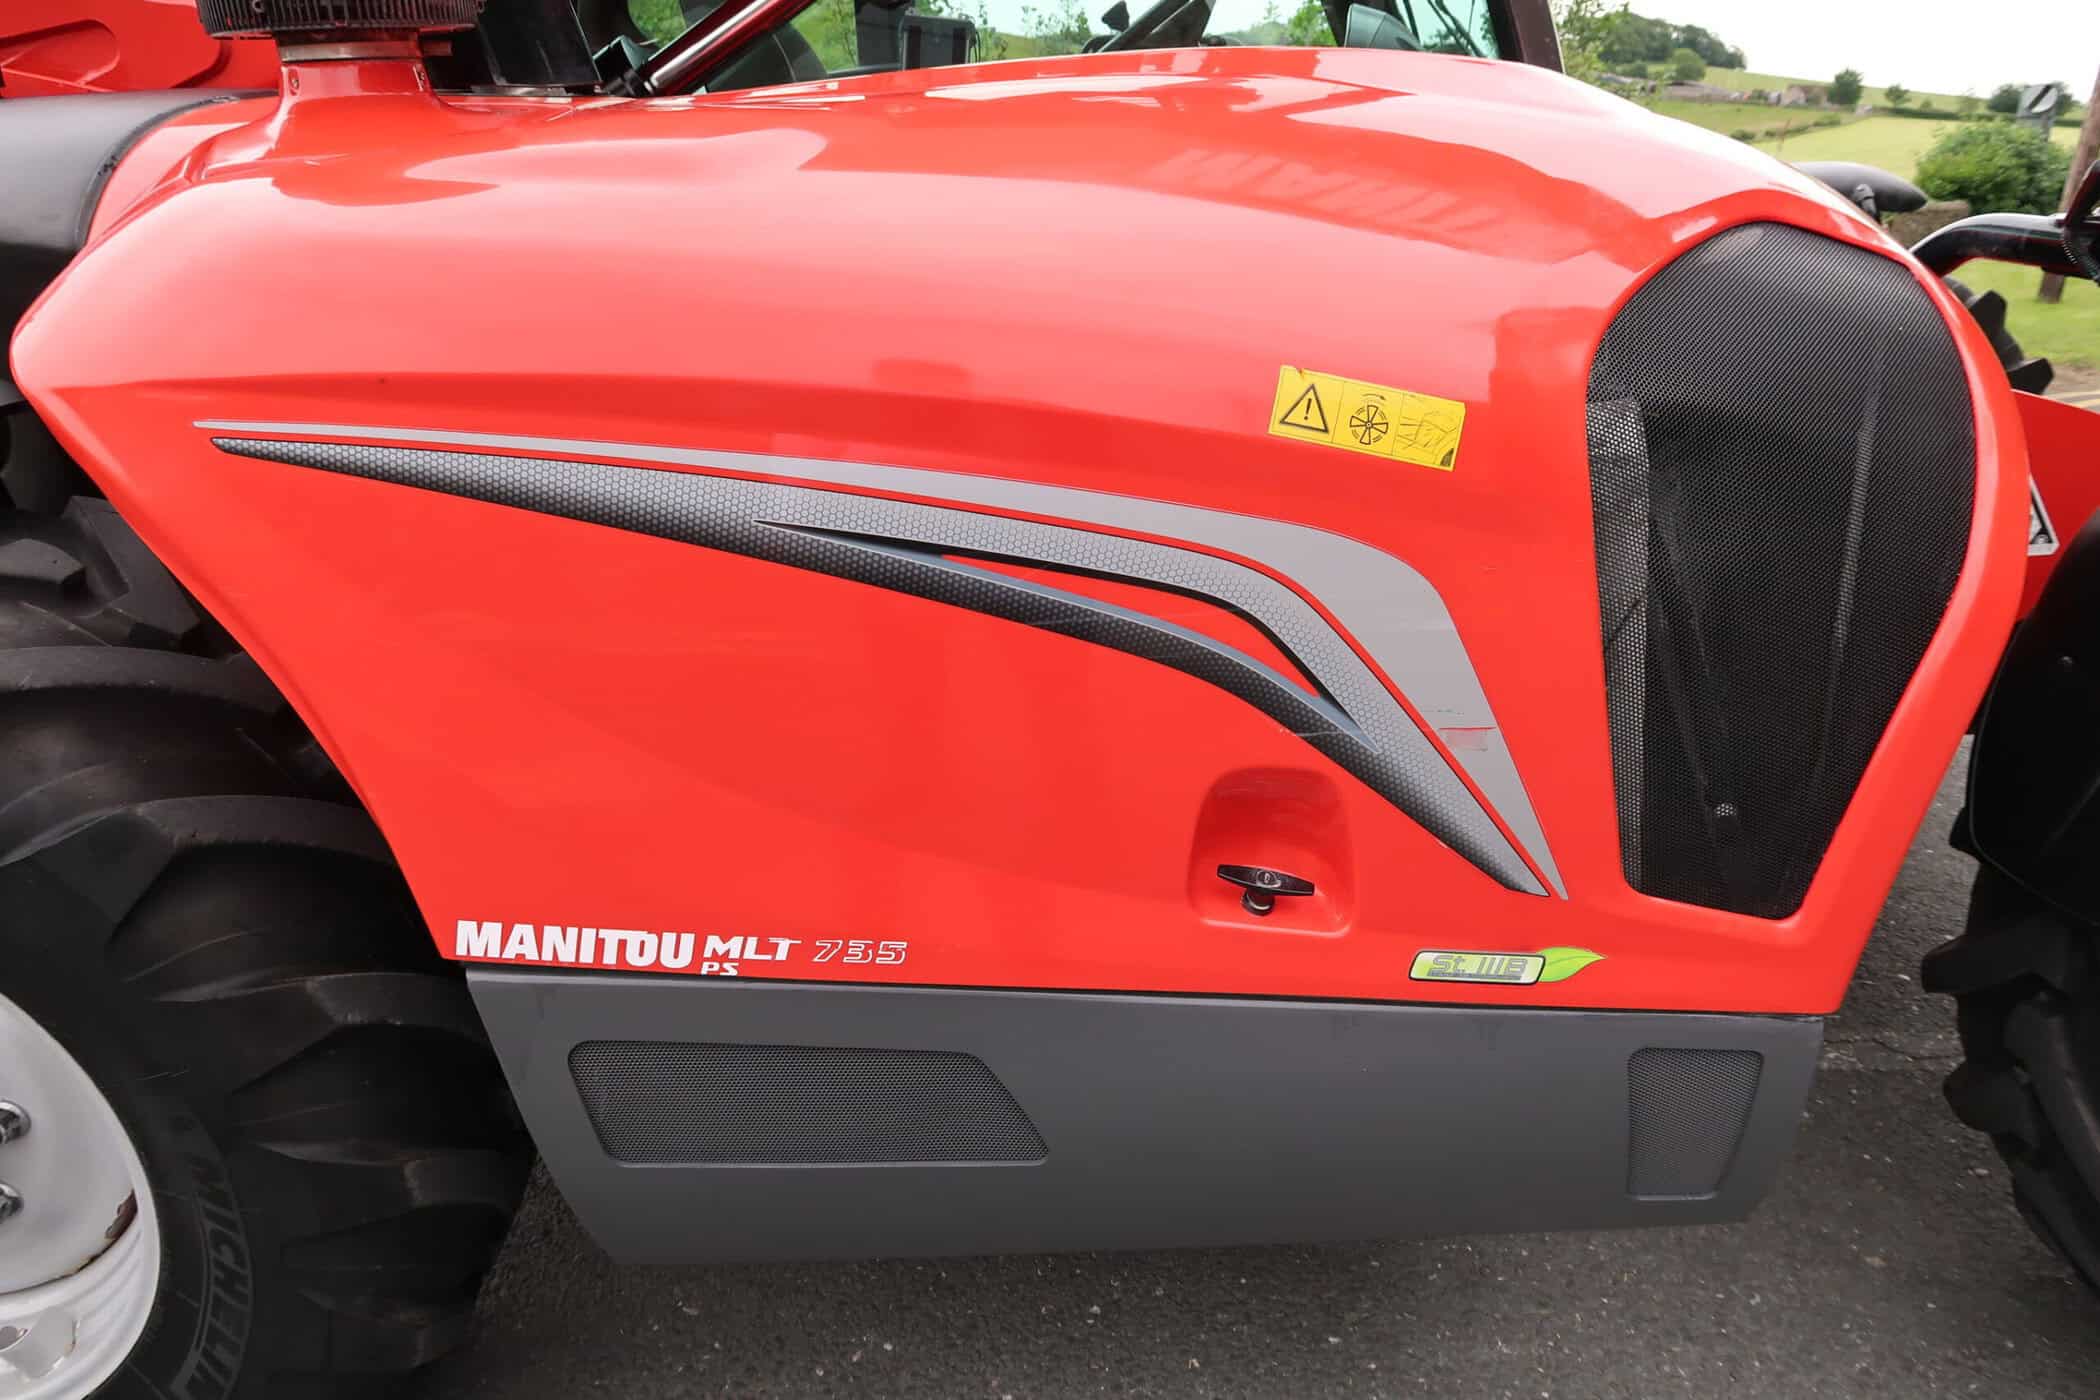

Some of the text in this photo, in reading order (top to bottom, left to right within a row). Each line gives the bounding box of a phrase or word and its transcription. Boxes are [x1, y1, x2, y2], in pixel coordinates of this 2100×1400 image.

[455, 919, 907, 968] MANITOU MLT 735
[700, 961, 739, 976] PS
